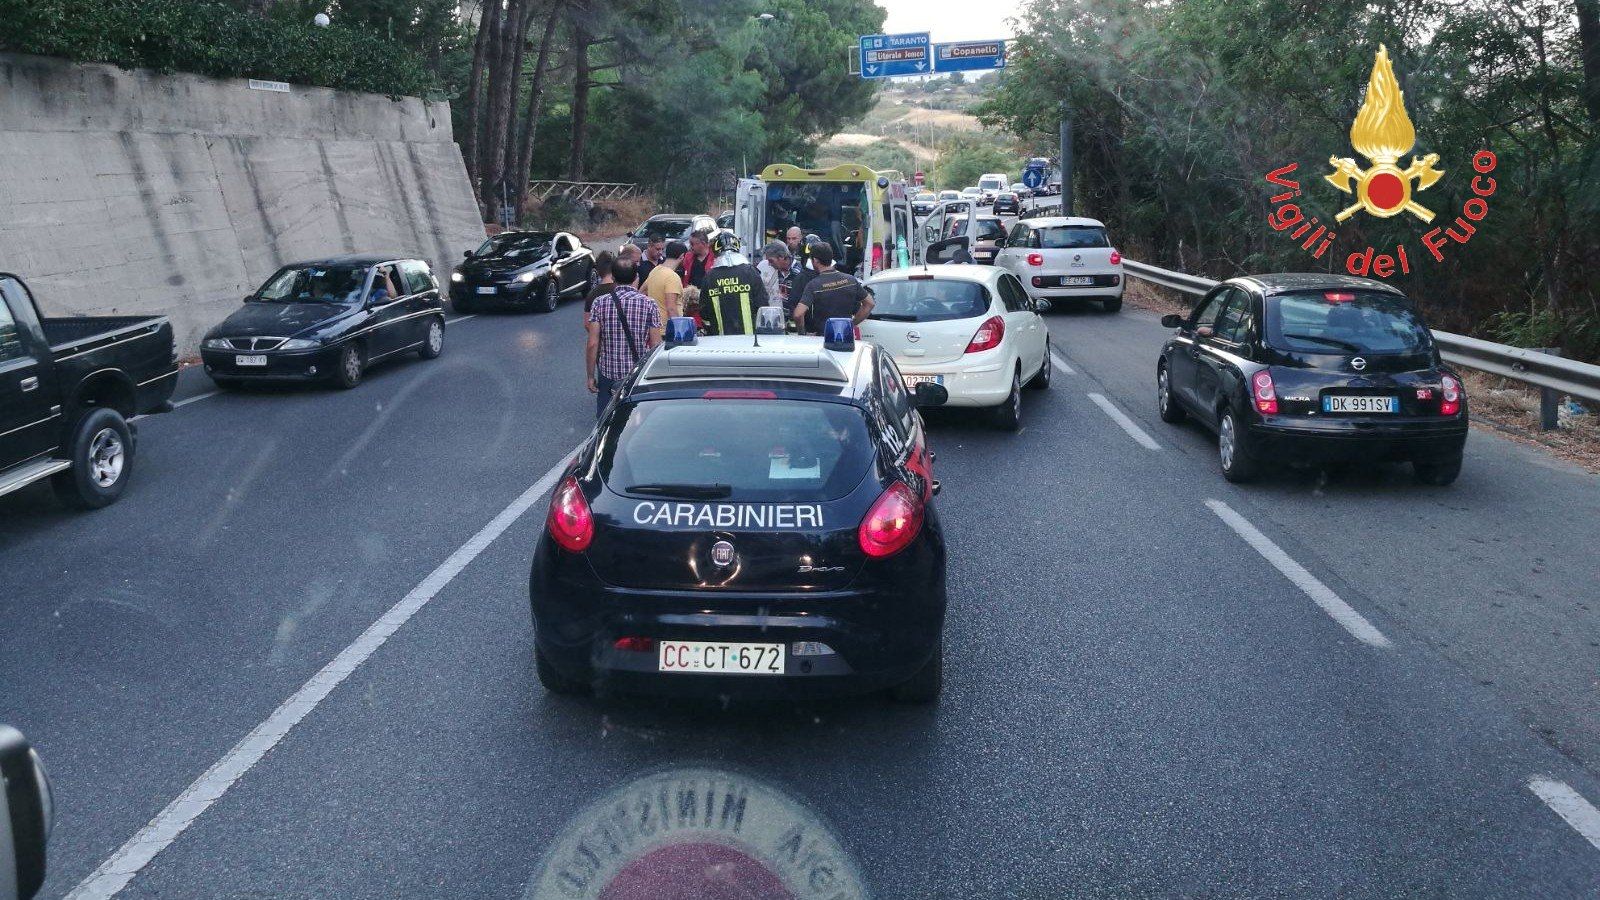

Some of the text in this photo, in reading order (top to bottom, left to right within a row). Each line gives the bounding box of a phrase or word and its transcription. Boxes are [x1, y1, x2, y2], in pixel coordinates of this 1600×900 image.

[890, 36, 927, 46] TARANTO
[953, 46, 997, 56] Copanello
[716, 277, 739, 286] VIGILI
[708, 283, 751, 297] DEL FUOCO
[1332, 398, 1392, 411] DK 991SV
[633, 501, 824, 527] CARABINIERI
[716, 548, 731, 560] FIAT
[664, 645, 780, 671] CC CT 672
